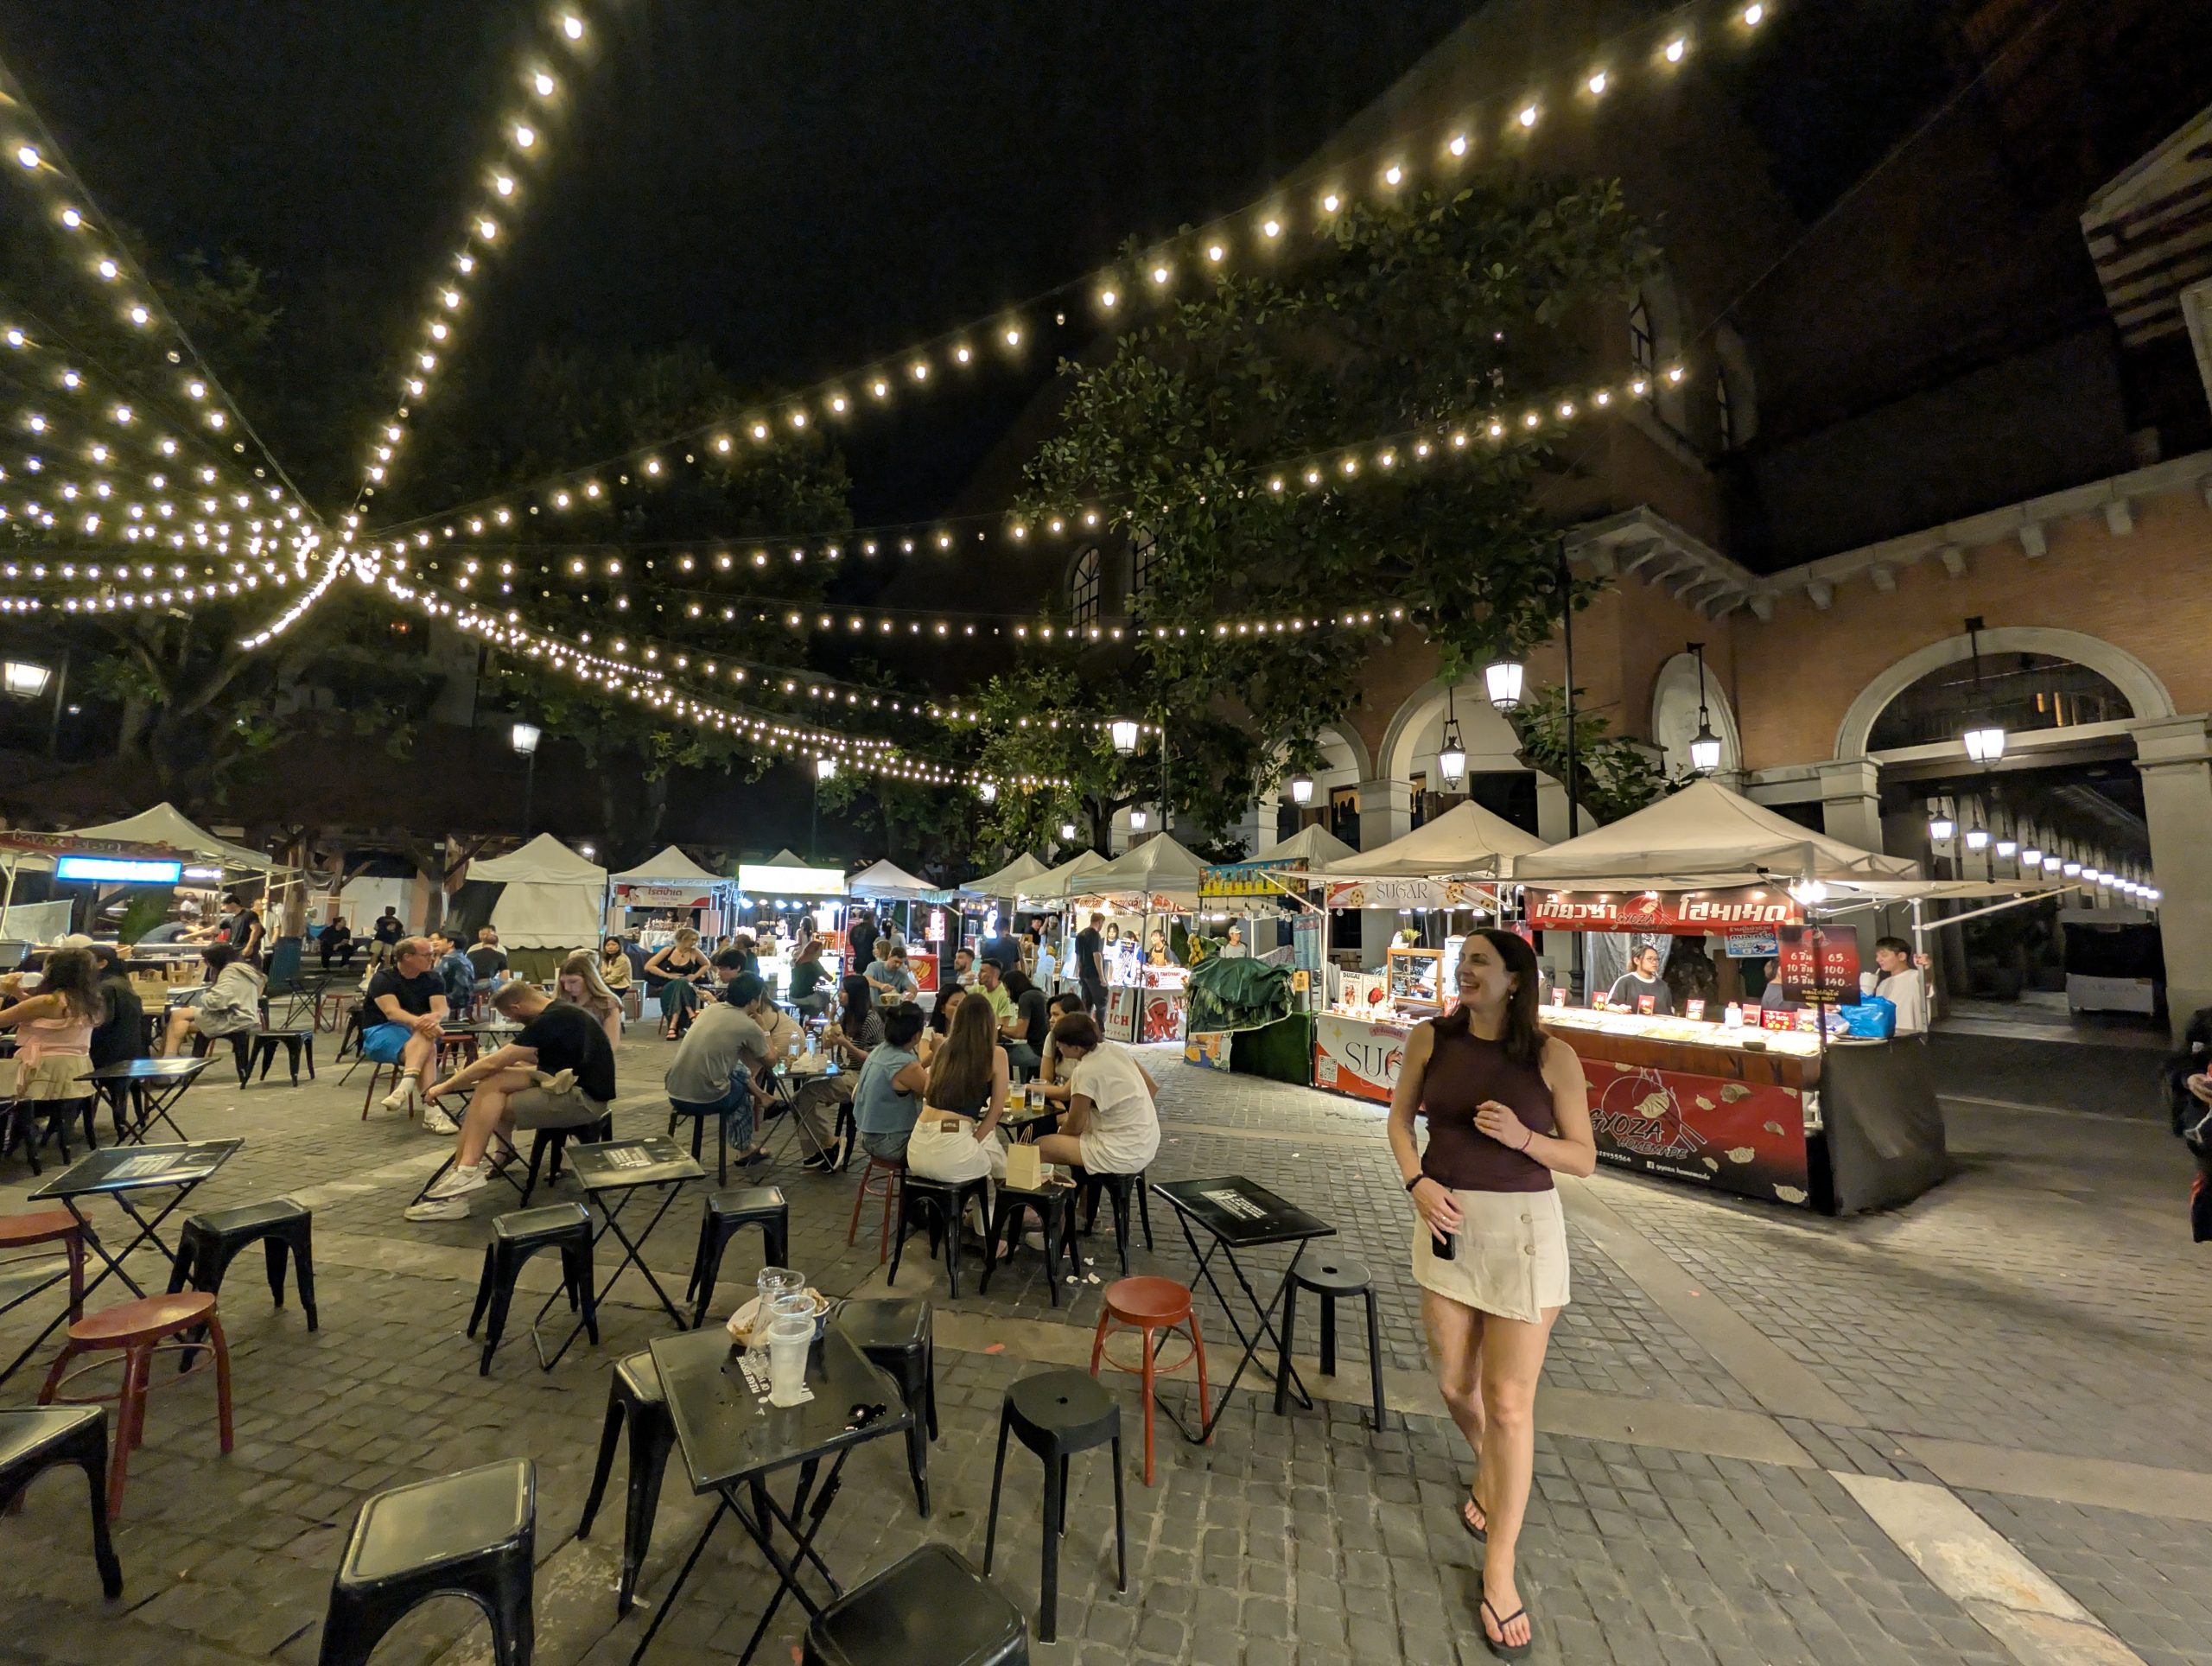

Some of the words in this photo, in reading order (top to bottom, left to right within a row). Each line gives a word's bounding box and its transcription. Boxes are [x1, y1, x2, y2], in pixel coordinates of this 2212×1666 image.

[1376, 882, 1428, 899] SUGAR
[1678, 893, 1787, 922] โฮมเมด
[1615, 912, 1656, 925] GYOZA
[1790, 952, 1797, 961] 6
[1787, 963, 1798, 972] 10
[1788, 975, 1799, 984] 15
[1344, 1041, 1403, 1082] SUG
[1590, 1108, 1665, 1143] GYOZA
[1617, 1135, 1689, 1160] HOMEMADE
[745, 1374, 760, 1394] PLEASE
